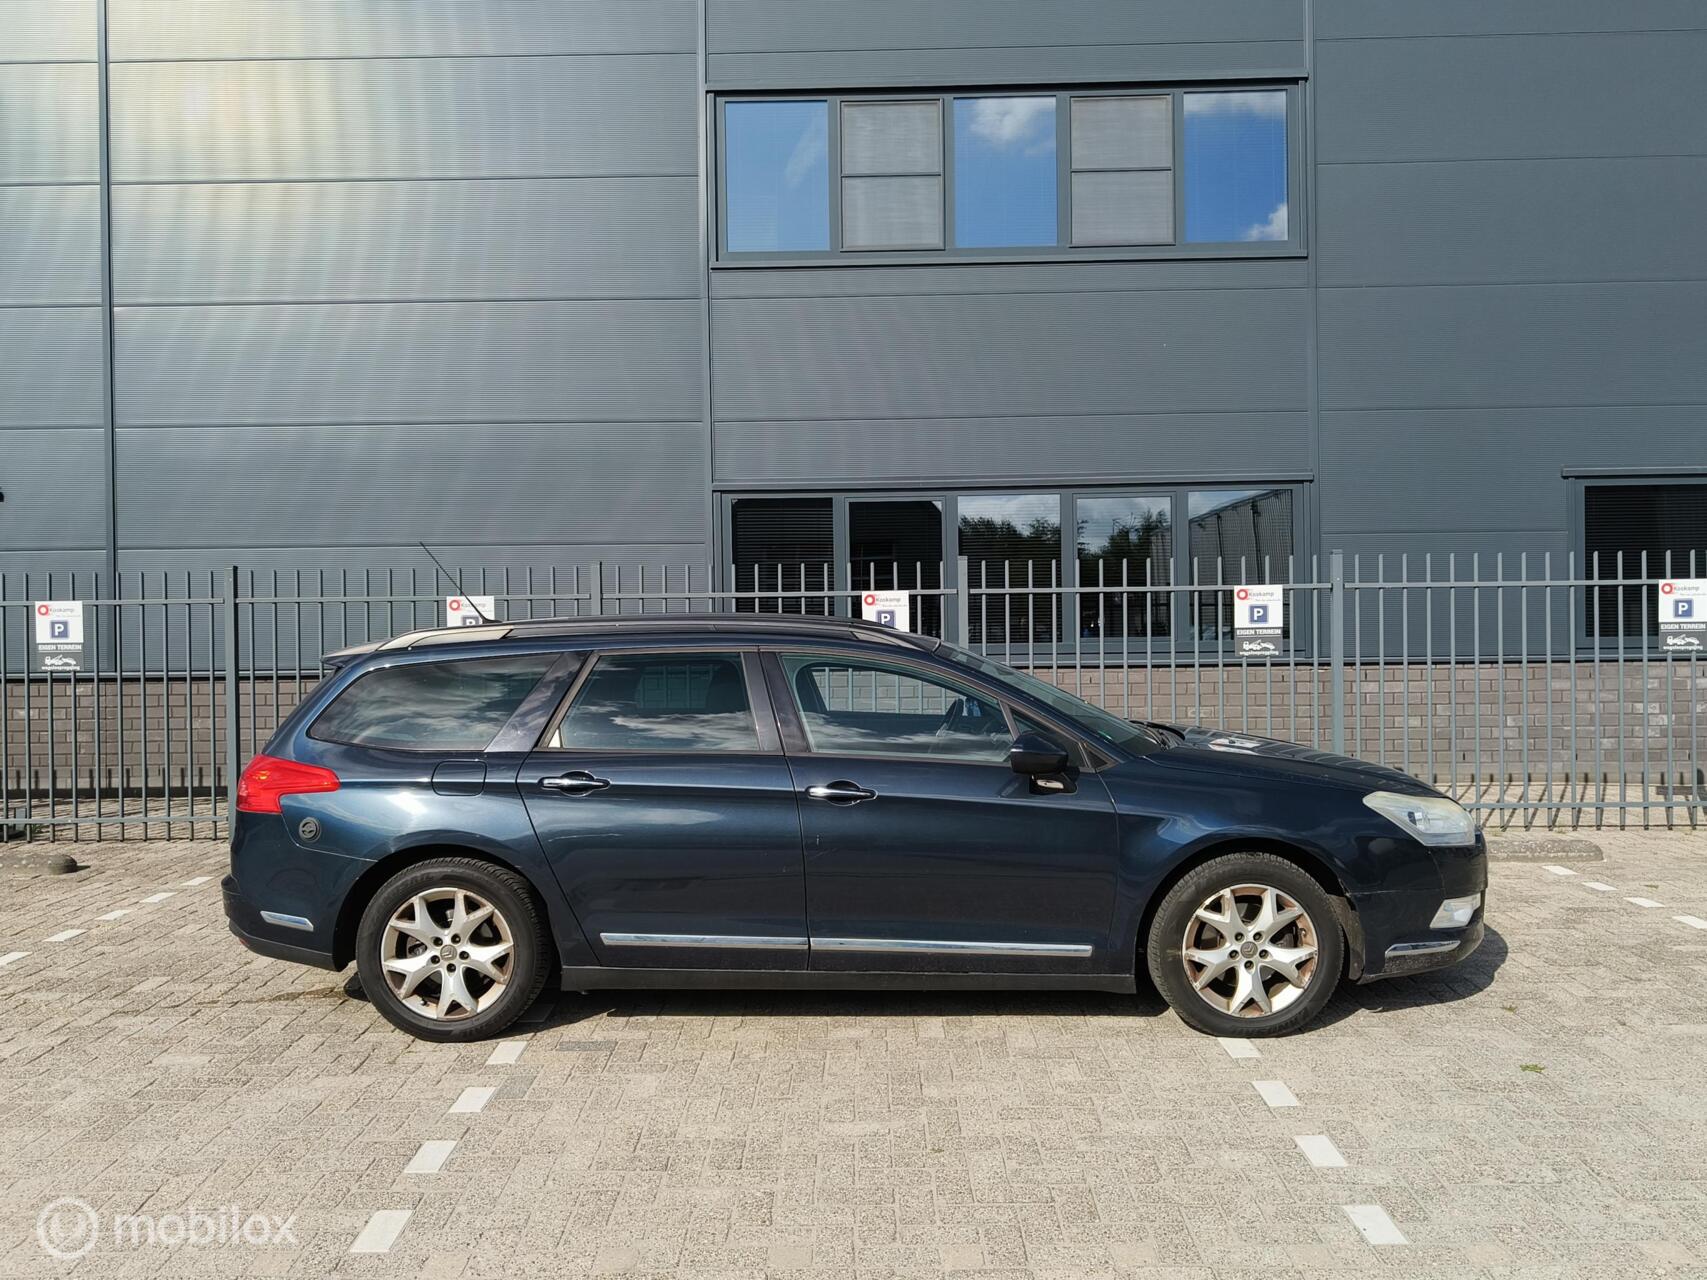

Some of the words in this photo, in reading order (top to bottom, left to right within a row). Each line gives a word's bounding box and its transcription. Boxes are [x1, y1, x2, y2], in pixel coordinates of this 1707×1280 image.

[1253, 608, 1264, 620] P
[1678, 602, 1688, 615] P
[54, 623, 64, 636] P
